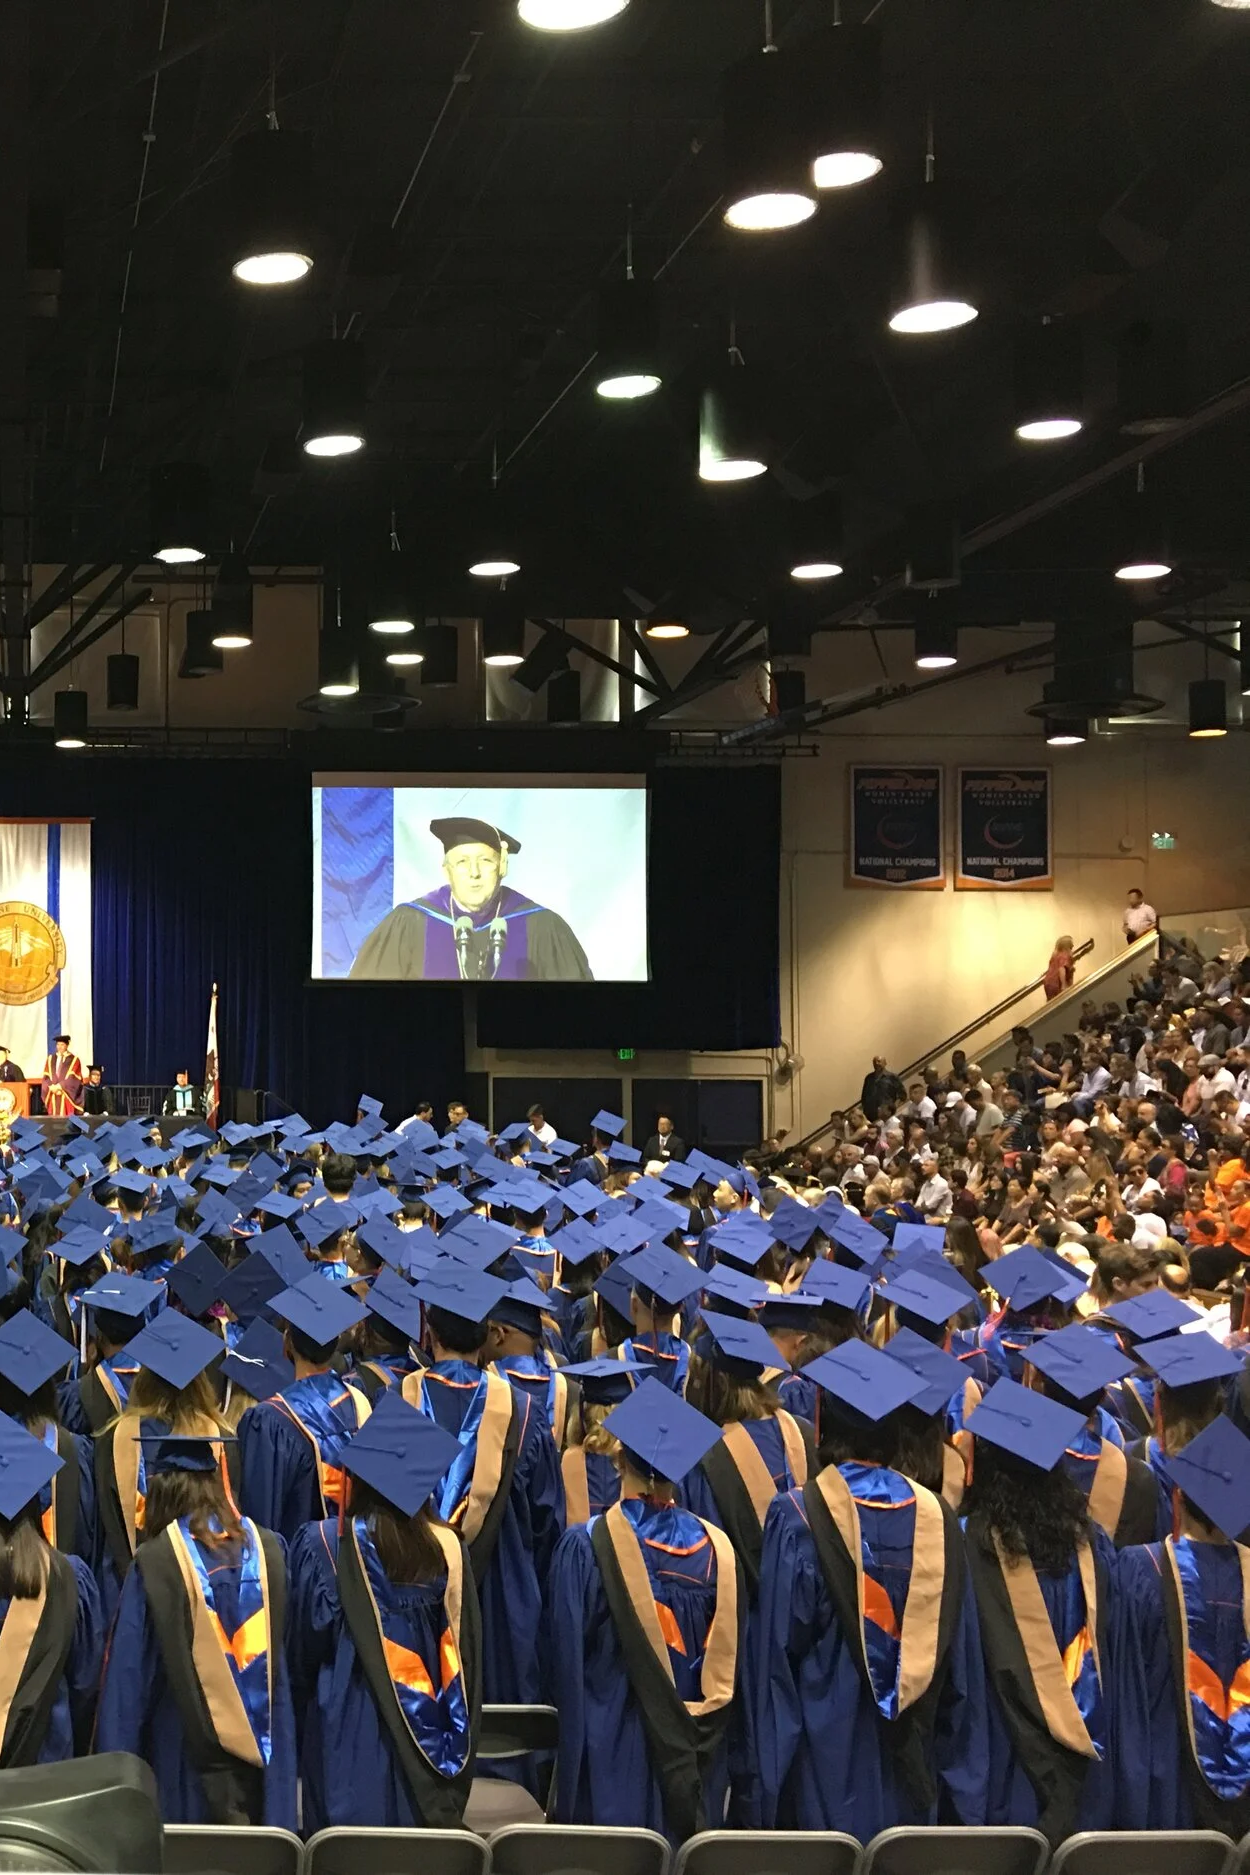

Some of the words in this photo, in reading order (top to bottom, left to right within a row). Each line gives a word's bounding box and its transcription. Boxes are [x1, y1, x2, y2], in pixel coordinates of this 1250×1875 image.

[859, 857, 894, 866] NATIONAL
[895, 857, 937, 867] CHAMPIONS
[966, 857, 1001, 866] NATIONAL
[1002, 857, 1045, 866] CHAMPIONS
[23, 905, 64, 954] UNIVERSITY
